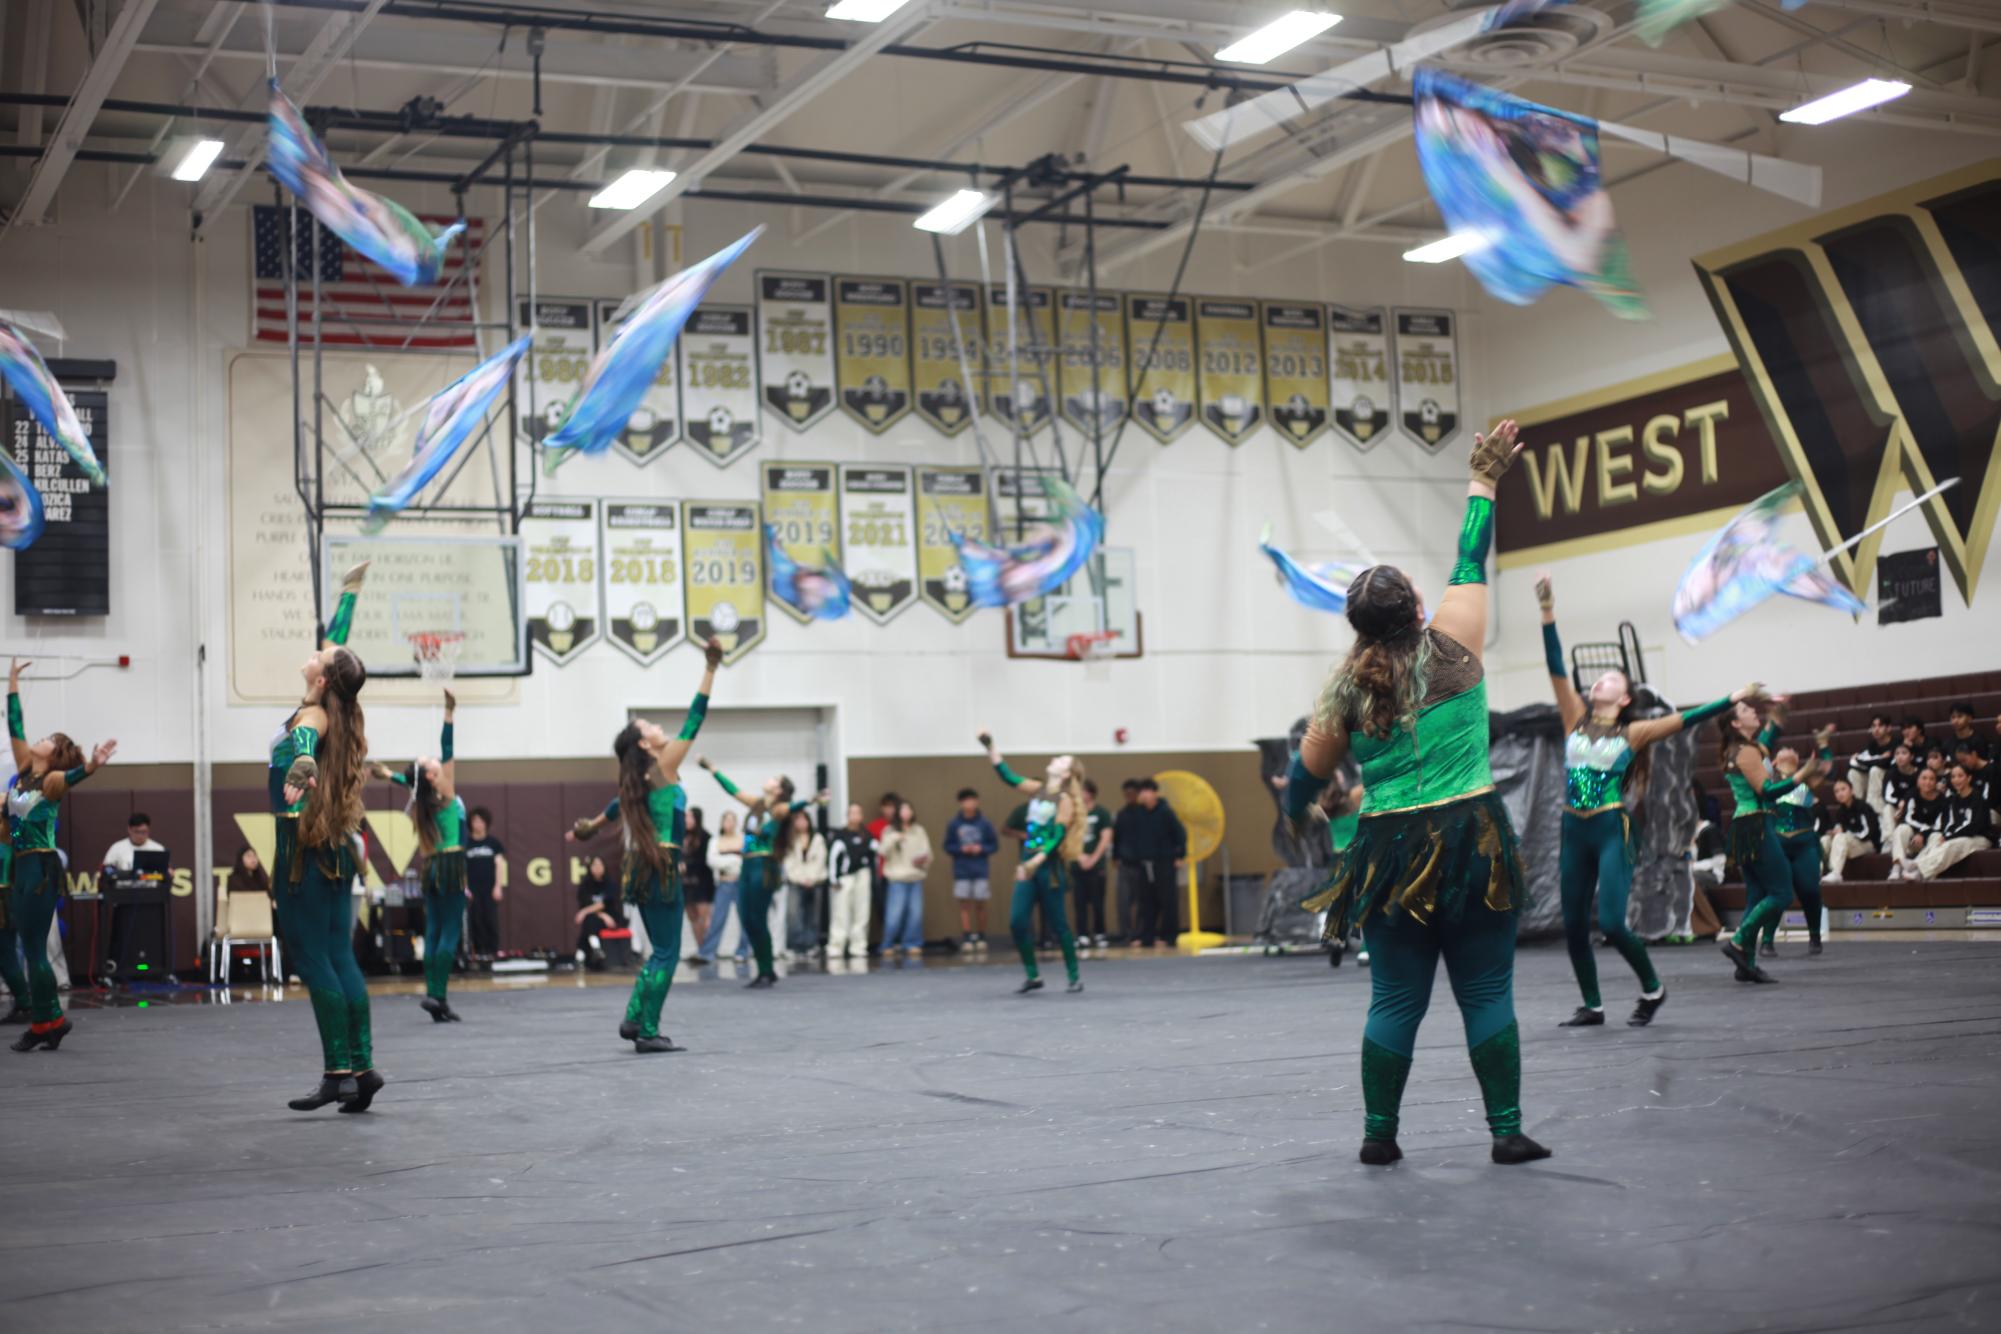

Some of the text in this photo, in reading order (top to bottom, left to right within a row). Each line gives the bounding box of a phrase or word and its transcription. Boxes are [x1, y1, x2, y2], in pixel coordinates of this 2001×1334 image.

[1522, 400, 1730, 521] WEST
[526, 558, 594, 584] 2018
[610, 559, 676, 585] 2018
[692, 560, 756, 585] 2019
